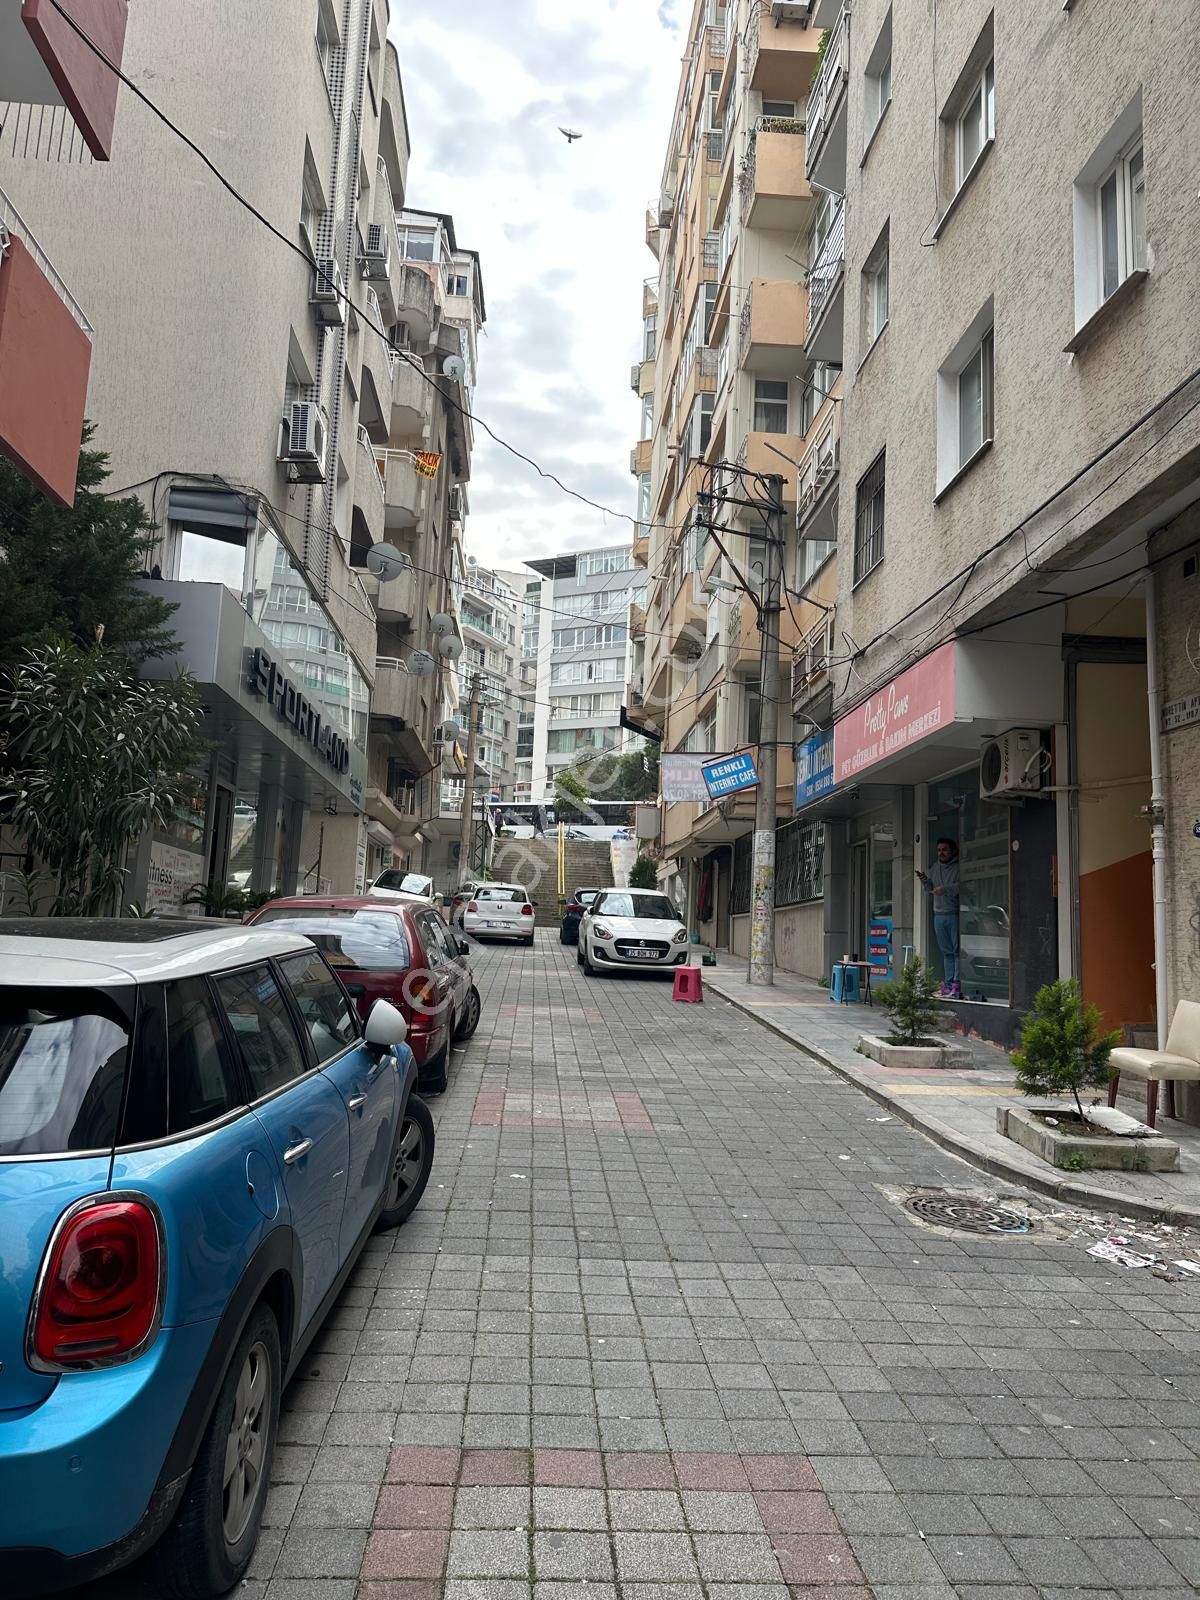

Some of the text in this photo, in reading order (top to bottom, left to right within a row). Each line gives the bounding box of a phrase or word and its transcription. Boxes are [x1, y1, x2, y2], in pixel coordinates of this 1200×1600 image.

[249, 647, 350, 775] SPORTLAND
[887, 683, 909, 724] Paws
[708, 768, 757, 793] İNTERNET CAFE
[711, 757, 746, 778] RENKLİ
[148, 859, 173, 885] itness
